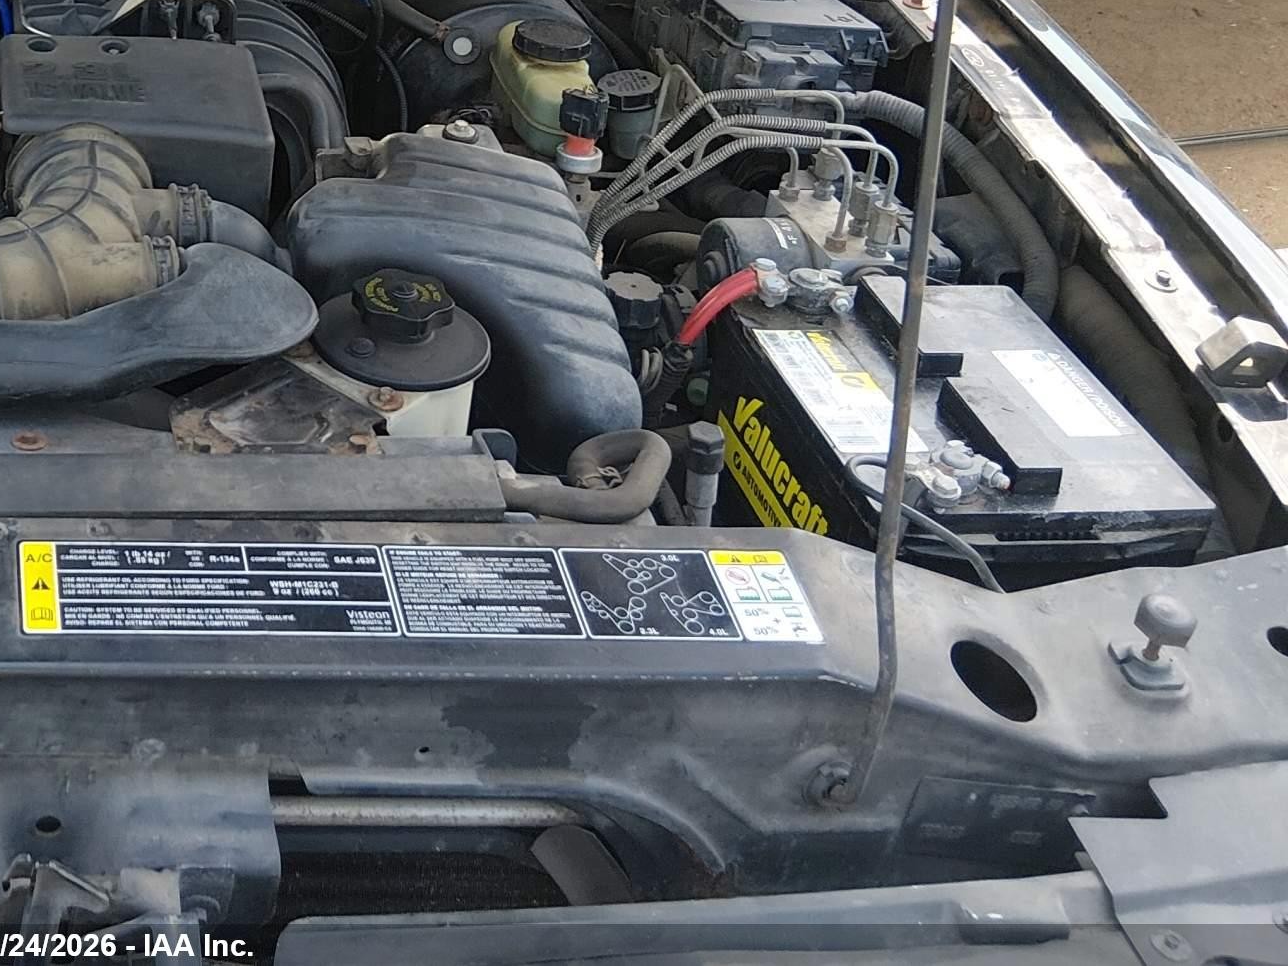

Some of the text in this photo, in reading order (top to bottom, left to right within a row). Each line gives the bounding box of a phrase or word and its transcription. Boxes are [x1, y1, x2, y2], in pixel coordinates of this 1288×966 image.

[733, 396, 828, 535] Valucraft
[742, 466, 781, 527] AUTOMOTIV
[25, 553, 53, 563] A/C
[209, 554, 241, 563] R-134a
[334, 556, 354, 564] SAE
[345, 609, 391, 619] Visteon
